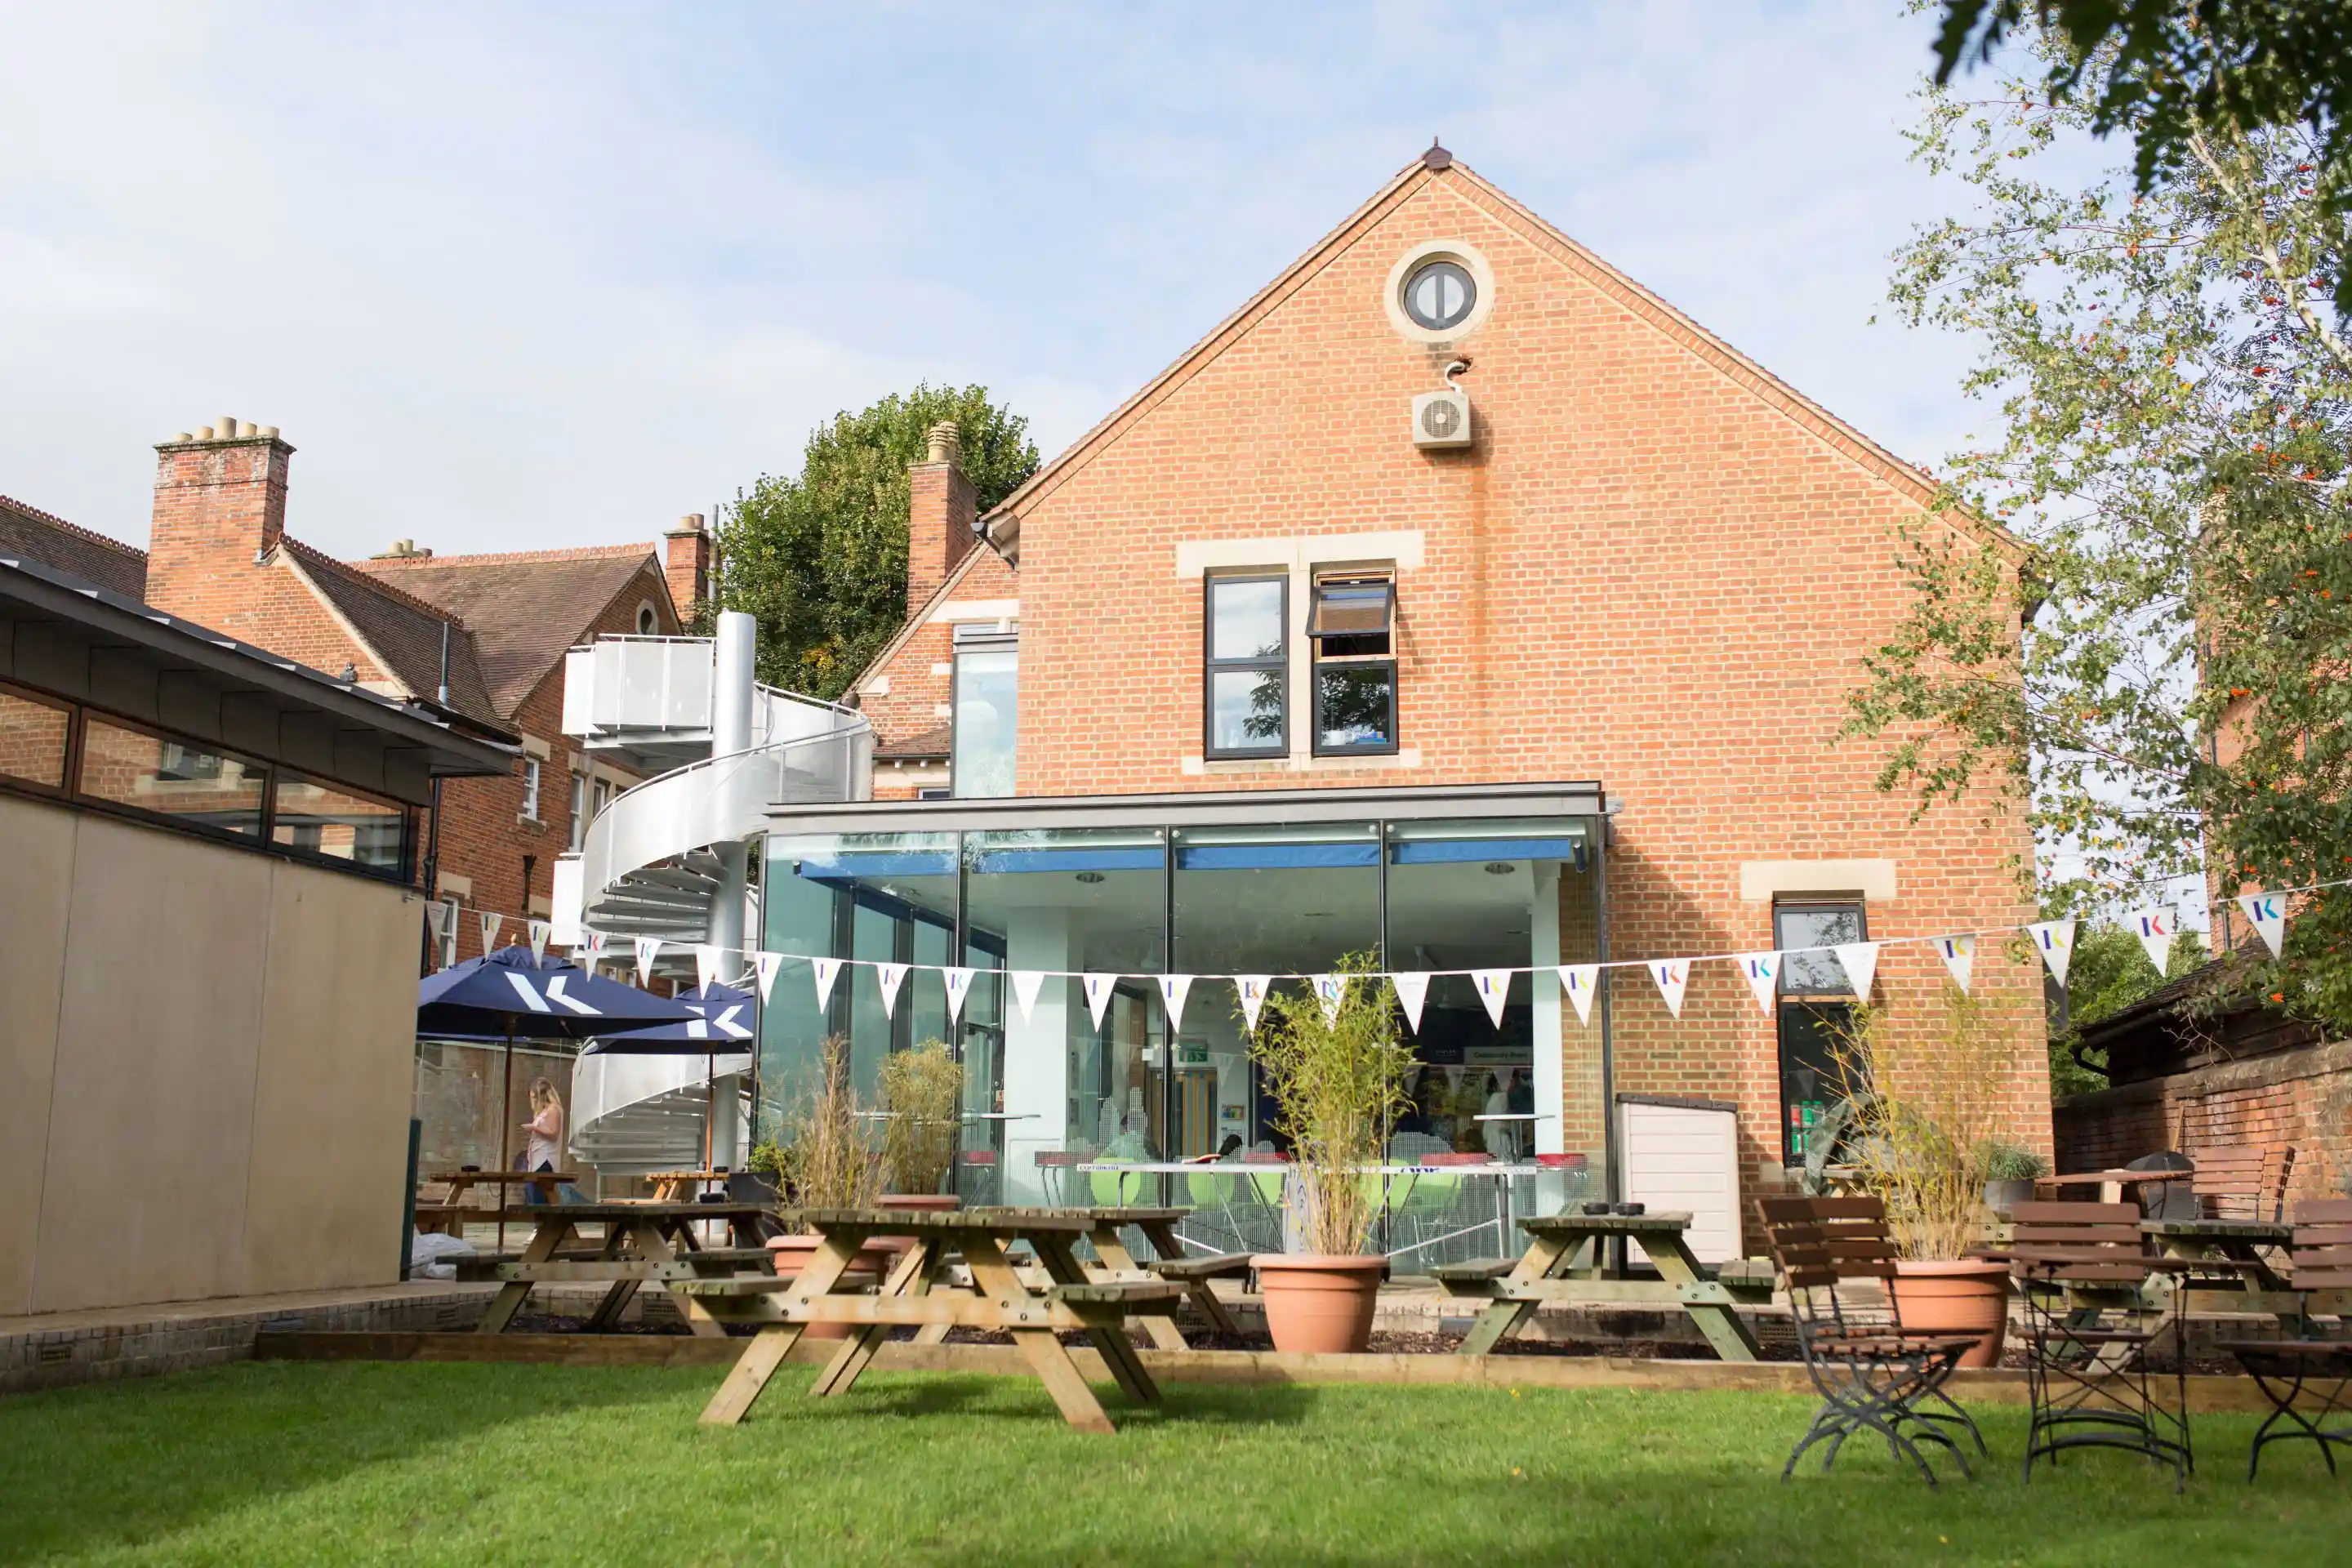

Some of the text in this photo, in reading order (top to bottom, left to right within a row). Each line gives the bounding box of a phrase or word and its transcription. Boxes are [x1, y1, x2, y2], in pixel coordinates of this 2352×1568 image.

[2253, 899, 2278, 921] K
[2141, 915, 2166, 937] K
[588, 934, 599, 951] K
[2043, 927, 2065, 949] K
[640, 943, 650, 958] K
[1945, 939, 1967, 958] K
[1662, 965, 1681, 985] K
[1751, 958, 1771, 978] K
[951, 973, 962, 990] K
[1484, 976, 1501, 994] K
[1570, 972, 1588, 990] K
[505, 971, 604, 1014] K
[684, 1004, 753, 1038] K
